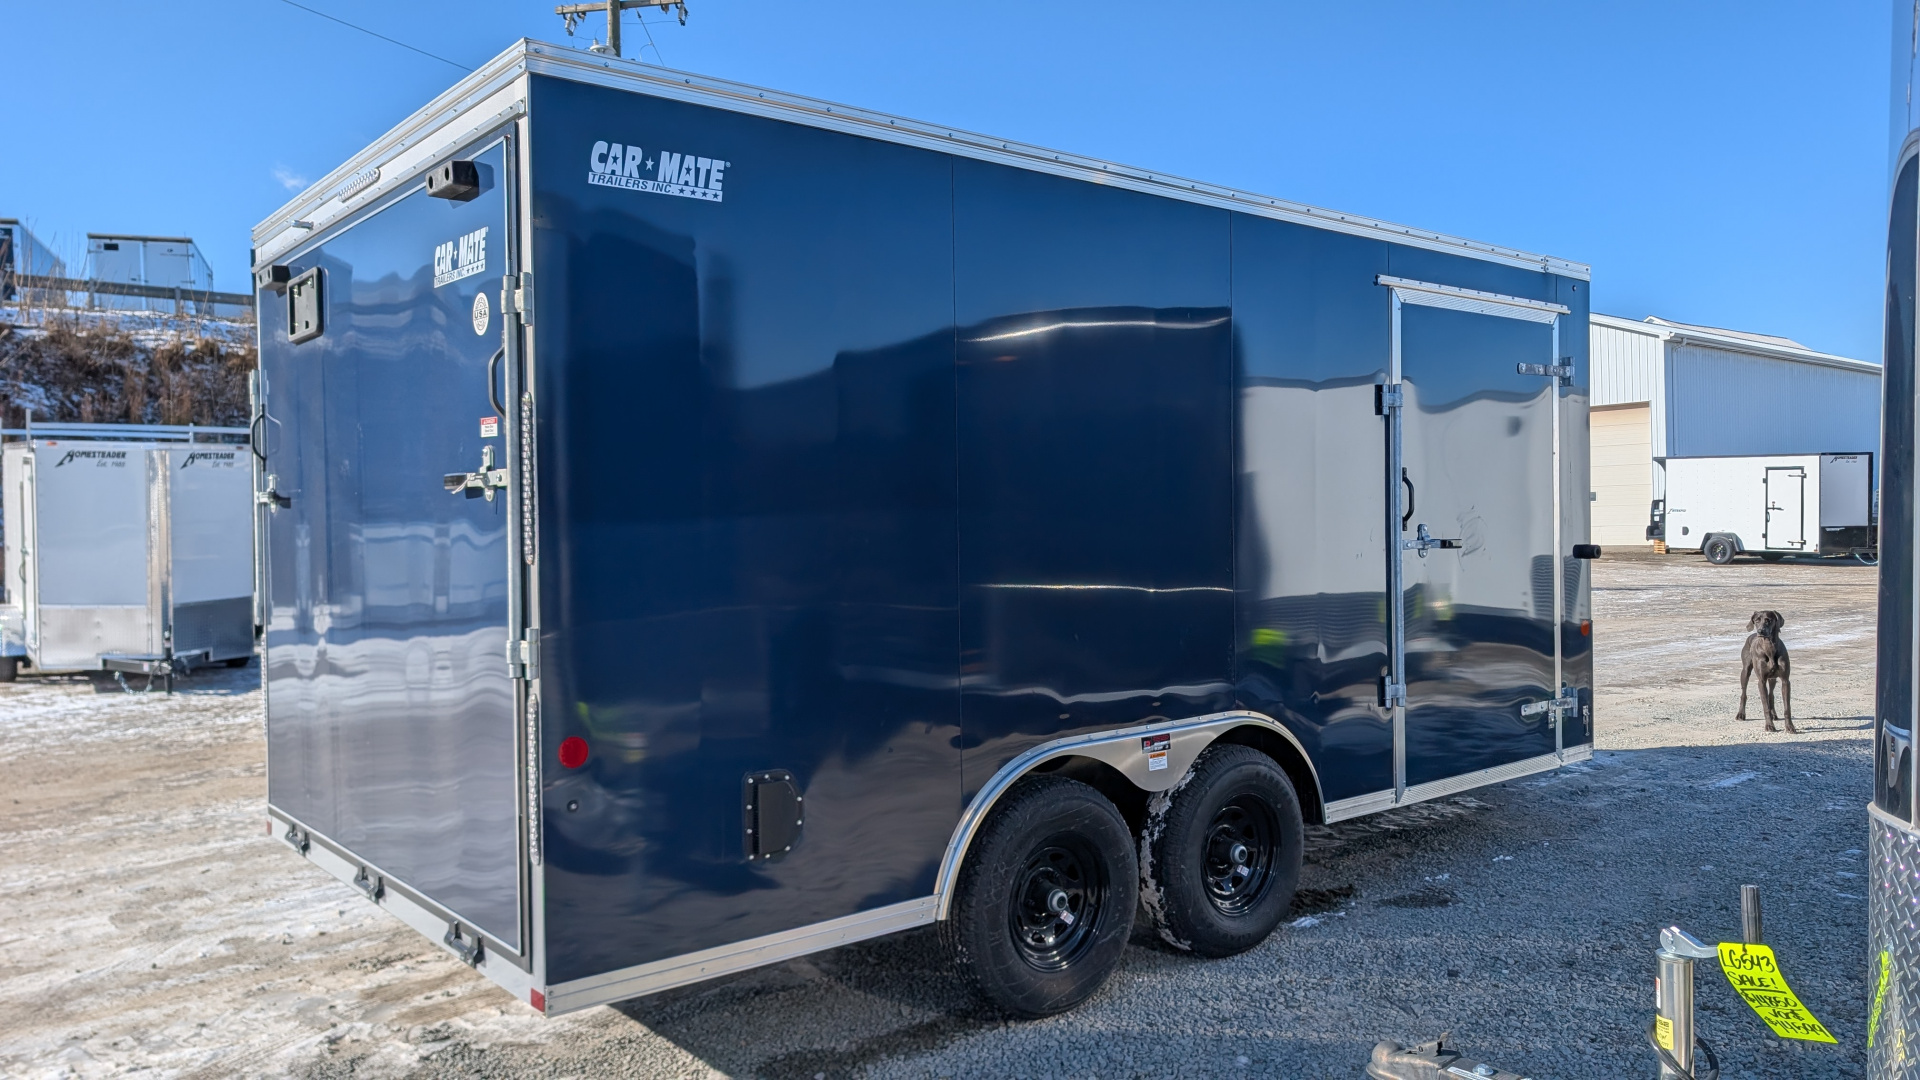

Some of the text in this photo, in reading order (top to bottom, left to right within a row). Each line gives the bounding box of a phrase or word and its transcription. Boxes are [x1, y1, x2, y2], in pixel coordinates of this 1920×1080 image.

[590, 140, 643, 179] CAR
[590, 173, 675, 195] TRAILERS INC.
[434, 240, 454, 278] CAR
[435, 270, 456, 287] TRAILERS
[474, 309, 487, 319] USA
[54, 449, 127, 468] HOMESTEADER
[180, 451, 235, 470] HOMESTEADER
[1719, 948, 1775, 973] LG543
[1727, 970, 1779, 989] SALE!
